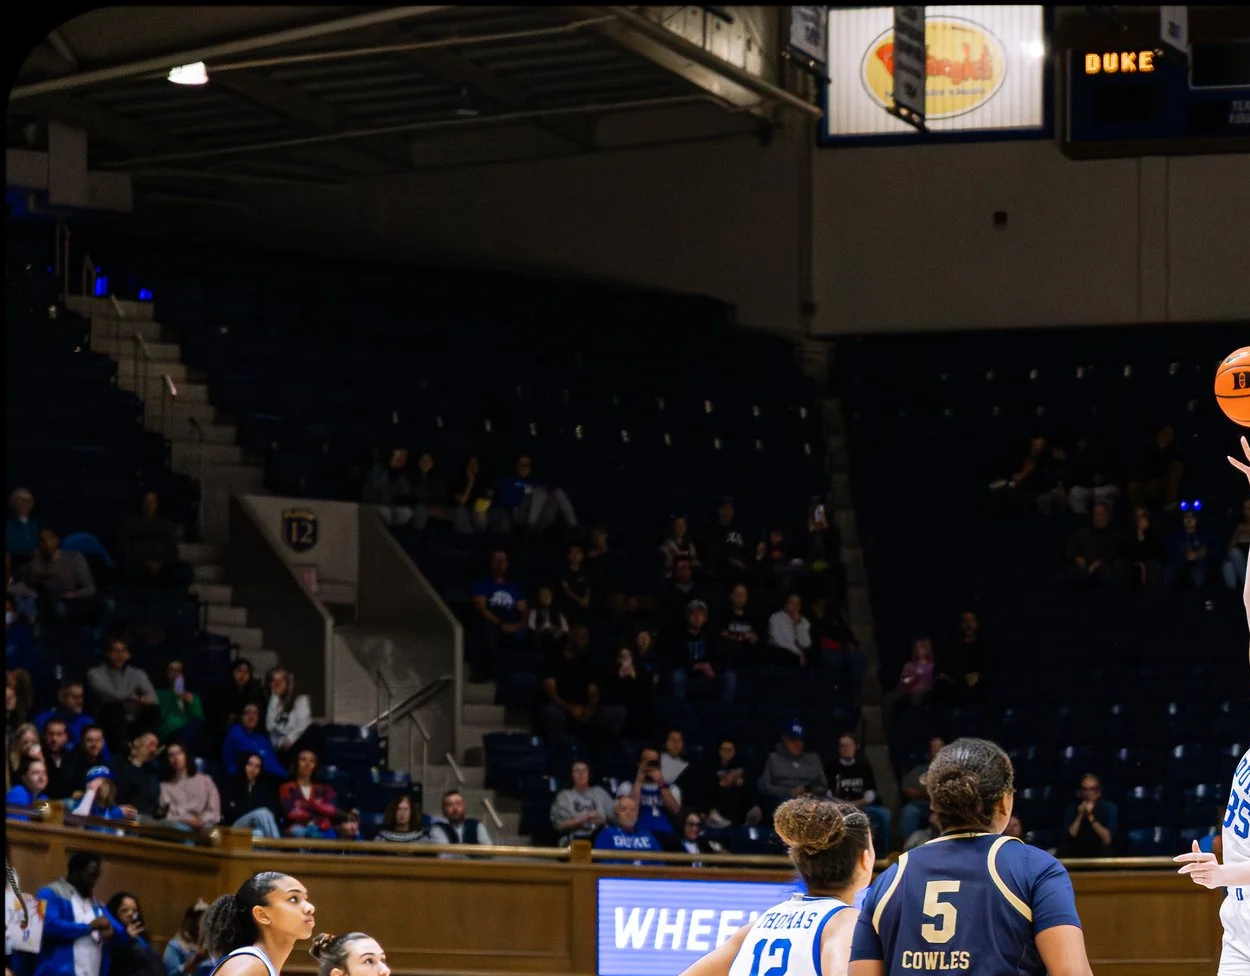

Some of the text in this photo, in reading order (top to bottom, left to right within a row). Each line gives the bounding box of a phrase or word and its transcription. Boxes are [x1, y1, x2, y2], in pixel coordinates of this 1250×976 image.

[1085, 51, 1155, 74] DUKE
[291, 521, 314, 543] 12
[757, 911, 818, 930] THOMAS
[920, 880, 961, 944] 5
[614, 906, 757, 951] WHEE
[901, 950, 971, 970] COWLES
